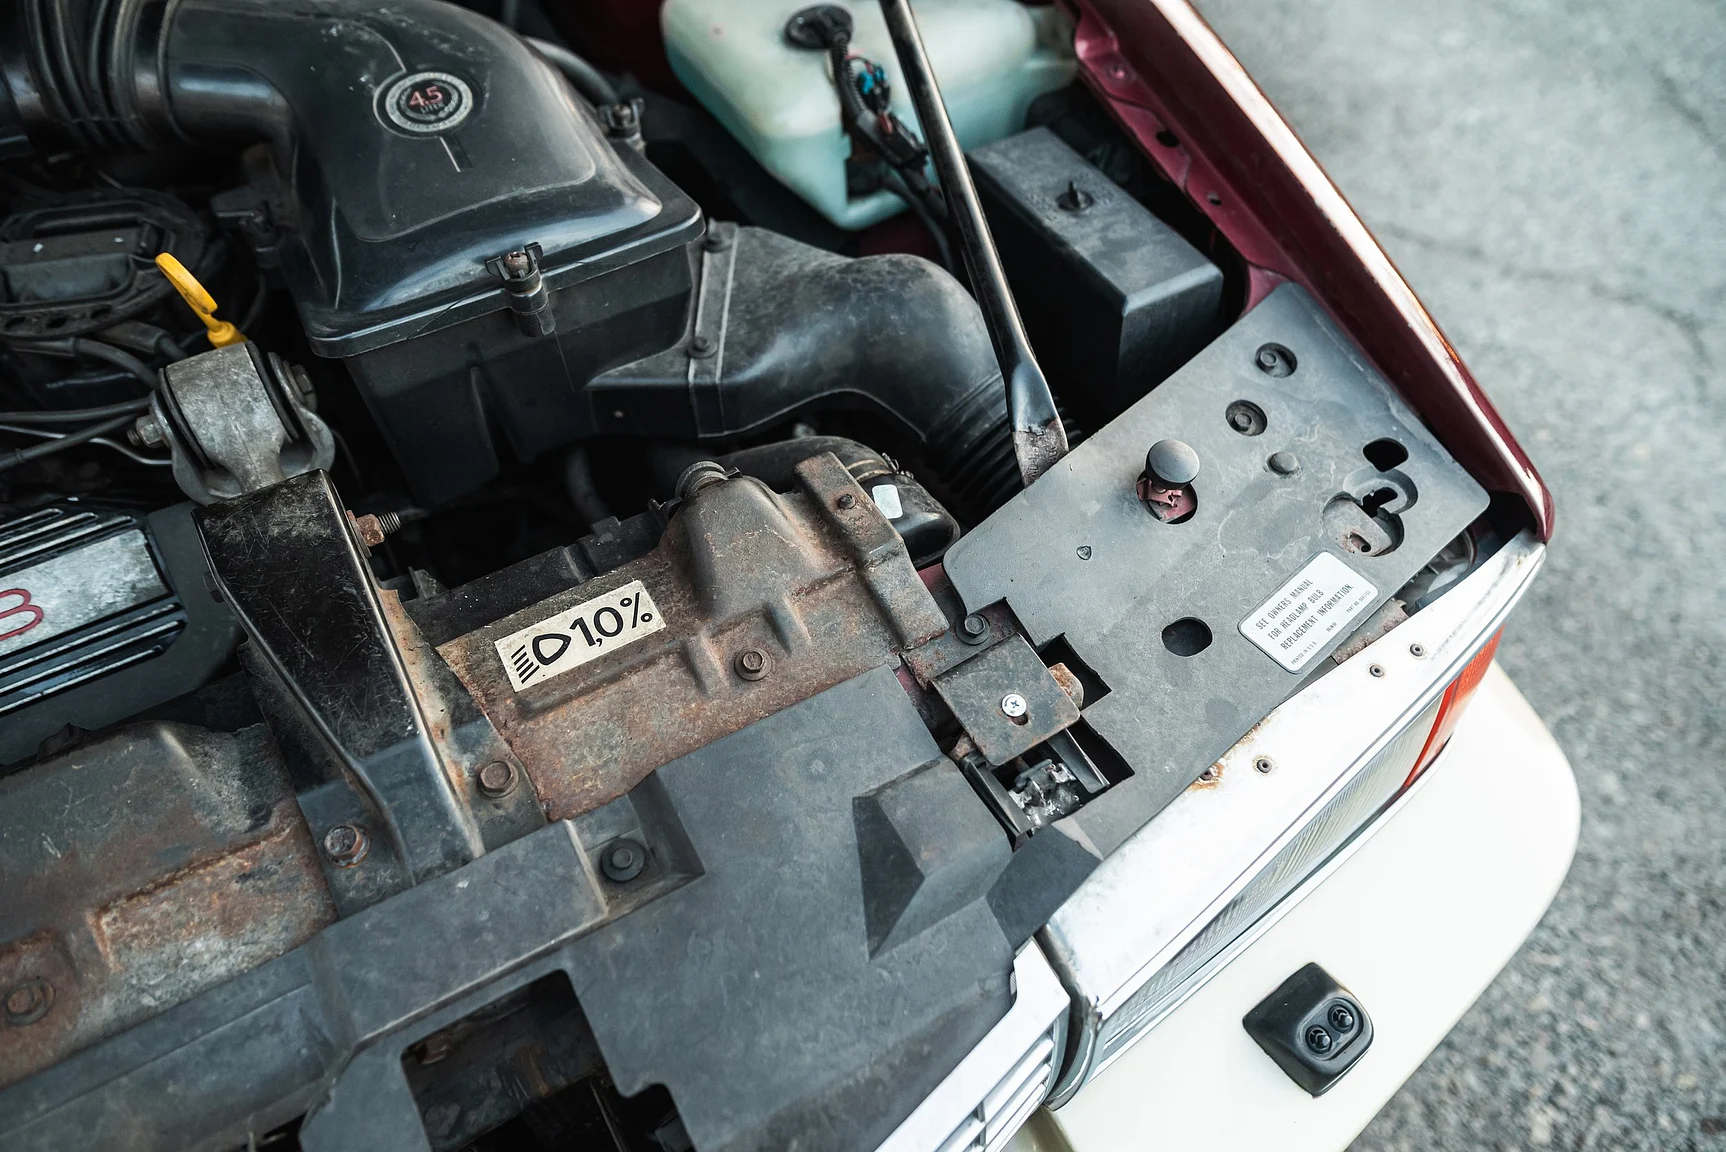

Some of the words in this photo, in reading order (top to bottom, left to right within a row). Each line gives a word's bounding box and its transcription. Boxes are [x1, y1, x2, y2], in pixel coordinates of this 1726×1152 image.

[409, 86, 443, 107] 4.5
[1255, 617, 1270, 630] SEE
[1267, 597, 1292, 619] OWNERS
[1290, 578, 1314, 599] MANUAL
[1267, 627, 1283, 640] FOR
[1280, 602, 1309, 630] HEADLAMP
[1307, 589, 1324, 604] BULB
[1280, 615, 1319, 650] REPLACEMENT
[1316, 583, 1355, 616] INFORMATION.
